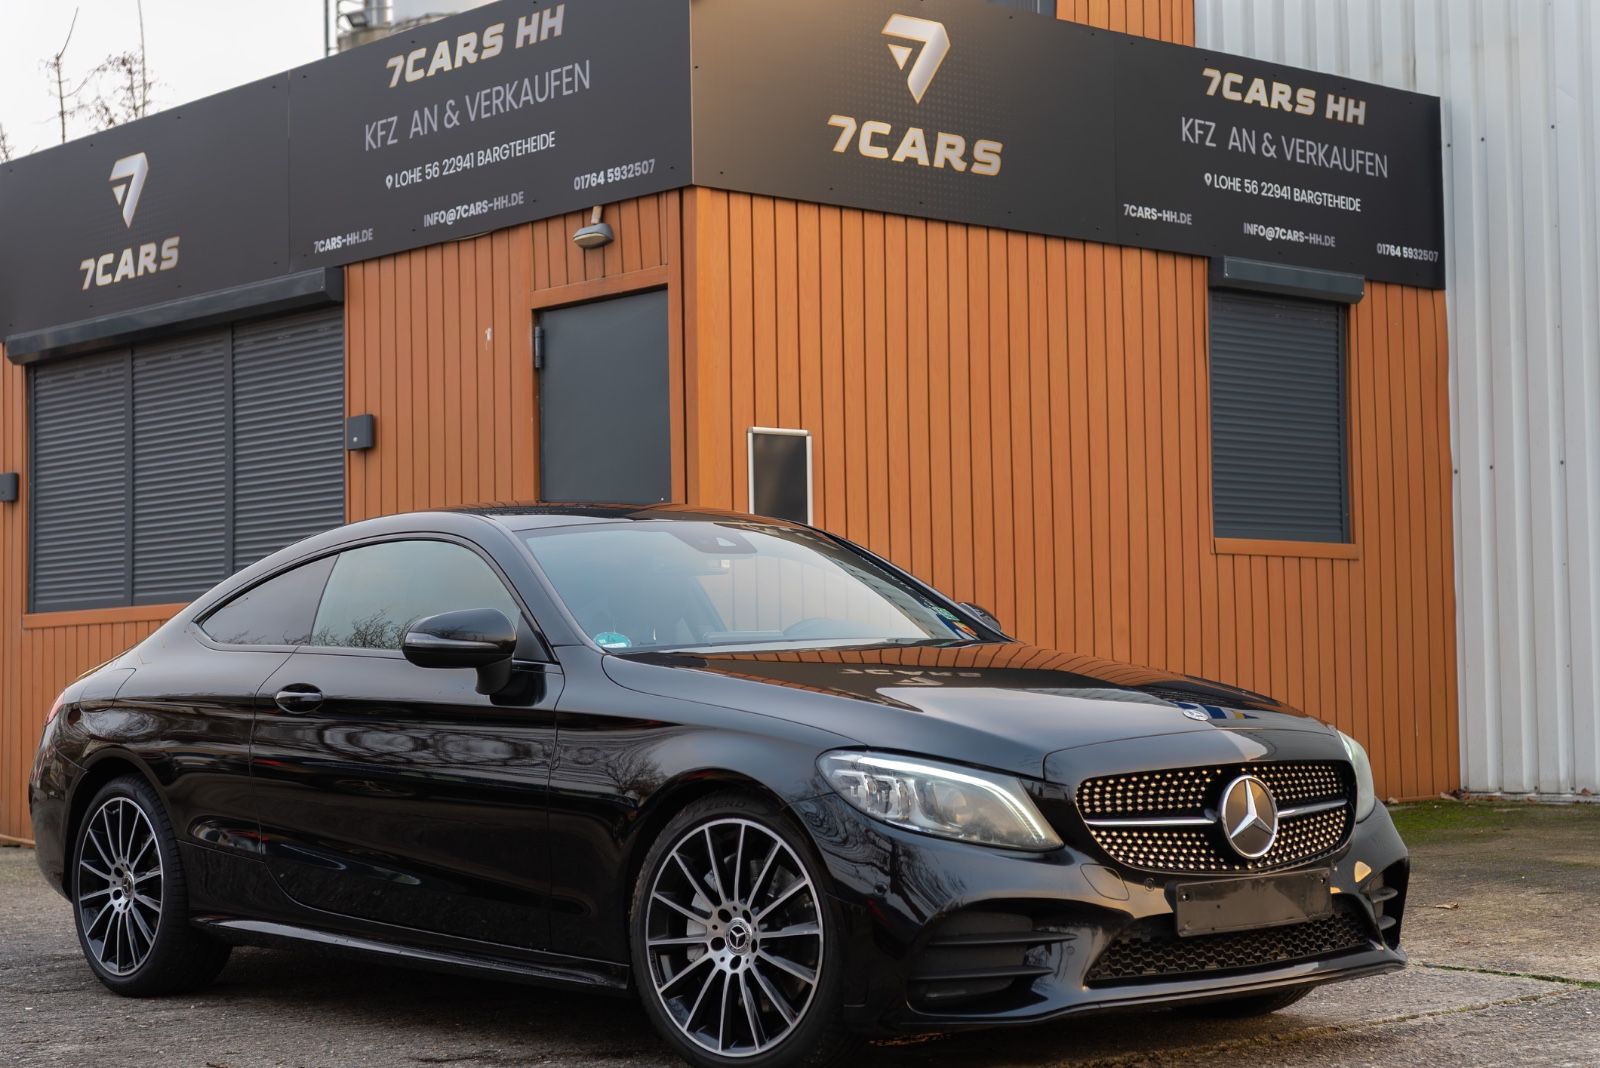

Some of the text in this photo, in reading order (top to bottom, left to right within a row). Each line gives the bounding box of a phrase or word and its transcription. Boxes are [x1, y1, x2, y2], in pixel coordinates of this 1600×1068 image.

[385, 4, 565, 88] 7CARS HH
[365, 60, 590, 151] KFZ AN & VERKAUFEN
[1202, 67, 1366, 126] 7CARS HH
[394, 130, 556, 188] LOHE 56 22941 BARGTEHEIDE
[827, 114, 1003, 176] 7CARS
[1181, 116, 1388, 178] KFZ AN & VERKAUFEN
[573, 158, 655, 190] 01764 5932507
[1214, 174, 1361, 212] LOHE 56 22941 BARGTEHEIDE
[423, 191, 524, 228] INFO@7CARS-HH.DE
[1123, 203, 1192, 225] 7CARS-HH.DE
[313, 228, 374, 254] 7CARS-HH.DE
[1243, 222, 1336, 247] INFO@7CARS-HH.DE
[1376, 242, 1439, 263] 01764 5932507
[80, 236, 180, 290] 7CARS
